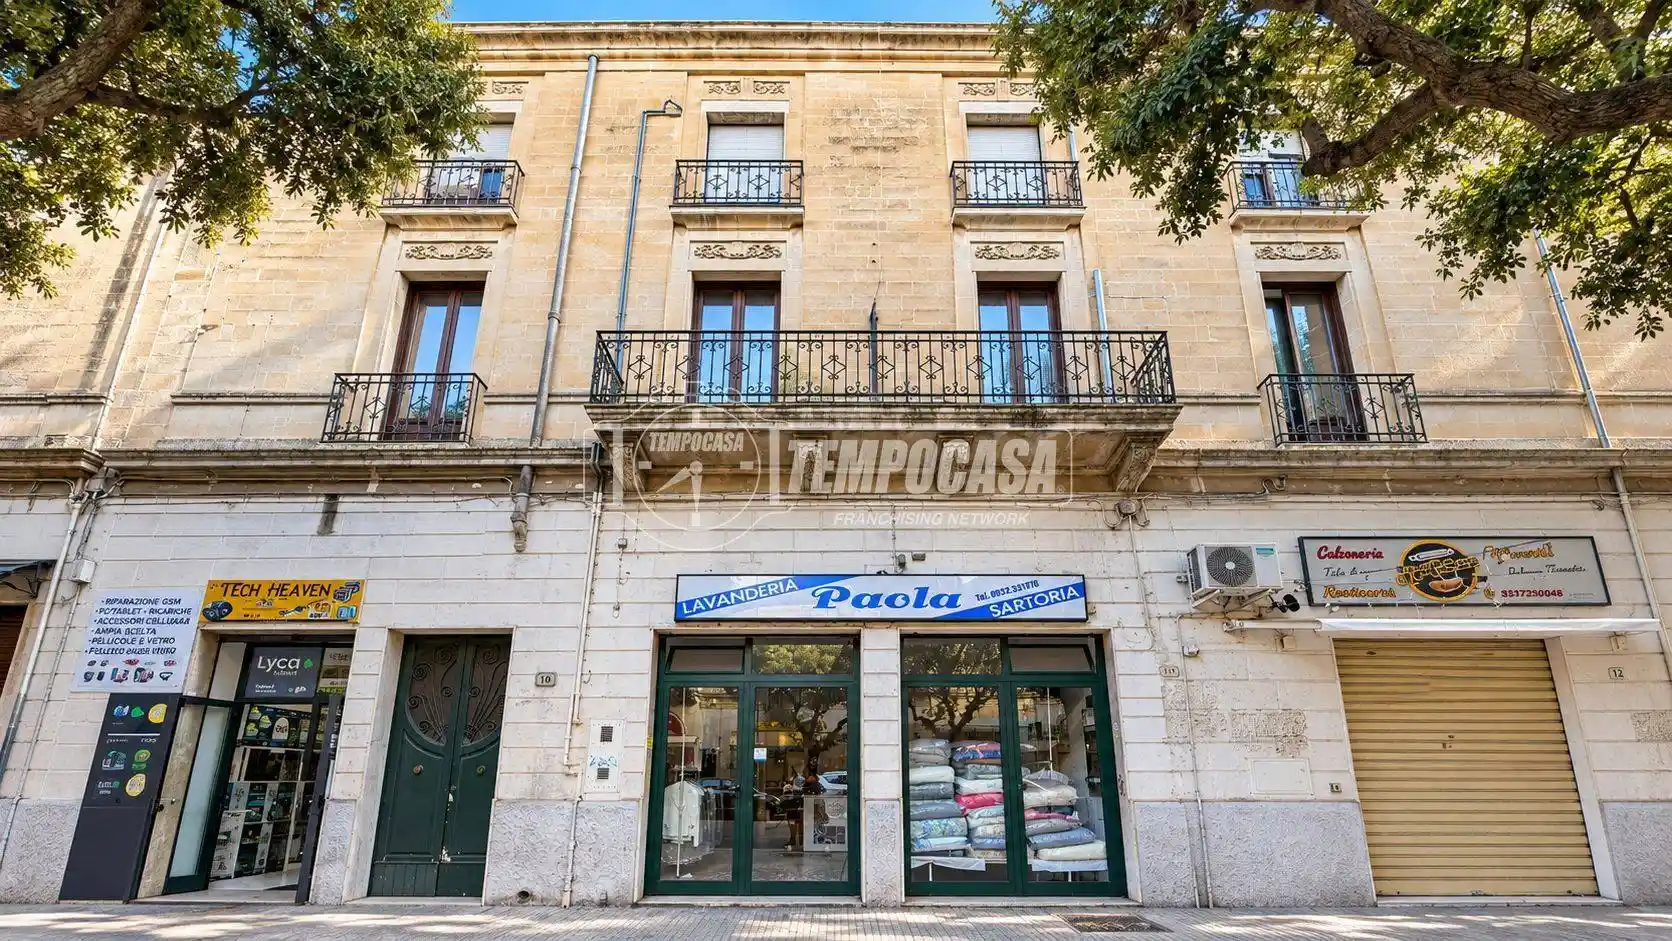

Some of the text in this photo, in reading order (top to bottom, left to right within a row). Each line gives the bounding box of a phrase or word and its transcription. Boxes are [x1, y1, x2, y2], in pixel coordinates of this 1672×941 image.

[1316, 545, 1385, 560] Calzoneria
[221, 582, 332, 597] TECH HEAVEN
[105, 597, 181, 605] RIPARAZIONE GSM
[682, 578, 799, 615] LAVANDERIA
[811, 585, 962, 609] Paola
[989, 586, 1080, 618] SARTORIA
[96, 617, 143, 625] ACCESSORI
[94, 627, 122, 635] AMPIA
[91, 637, 137, 645] PELLICOLE
[147, 637, 175, 645] VETRO
[257, 655, 301, 673] Lyca
[539, 675, 551, 684] 10
[1612, 669, 1624, 678] 12
